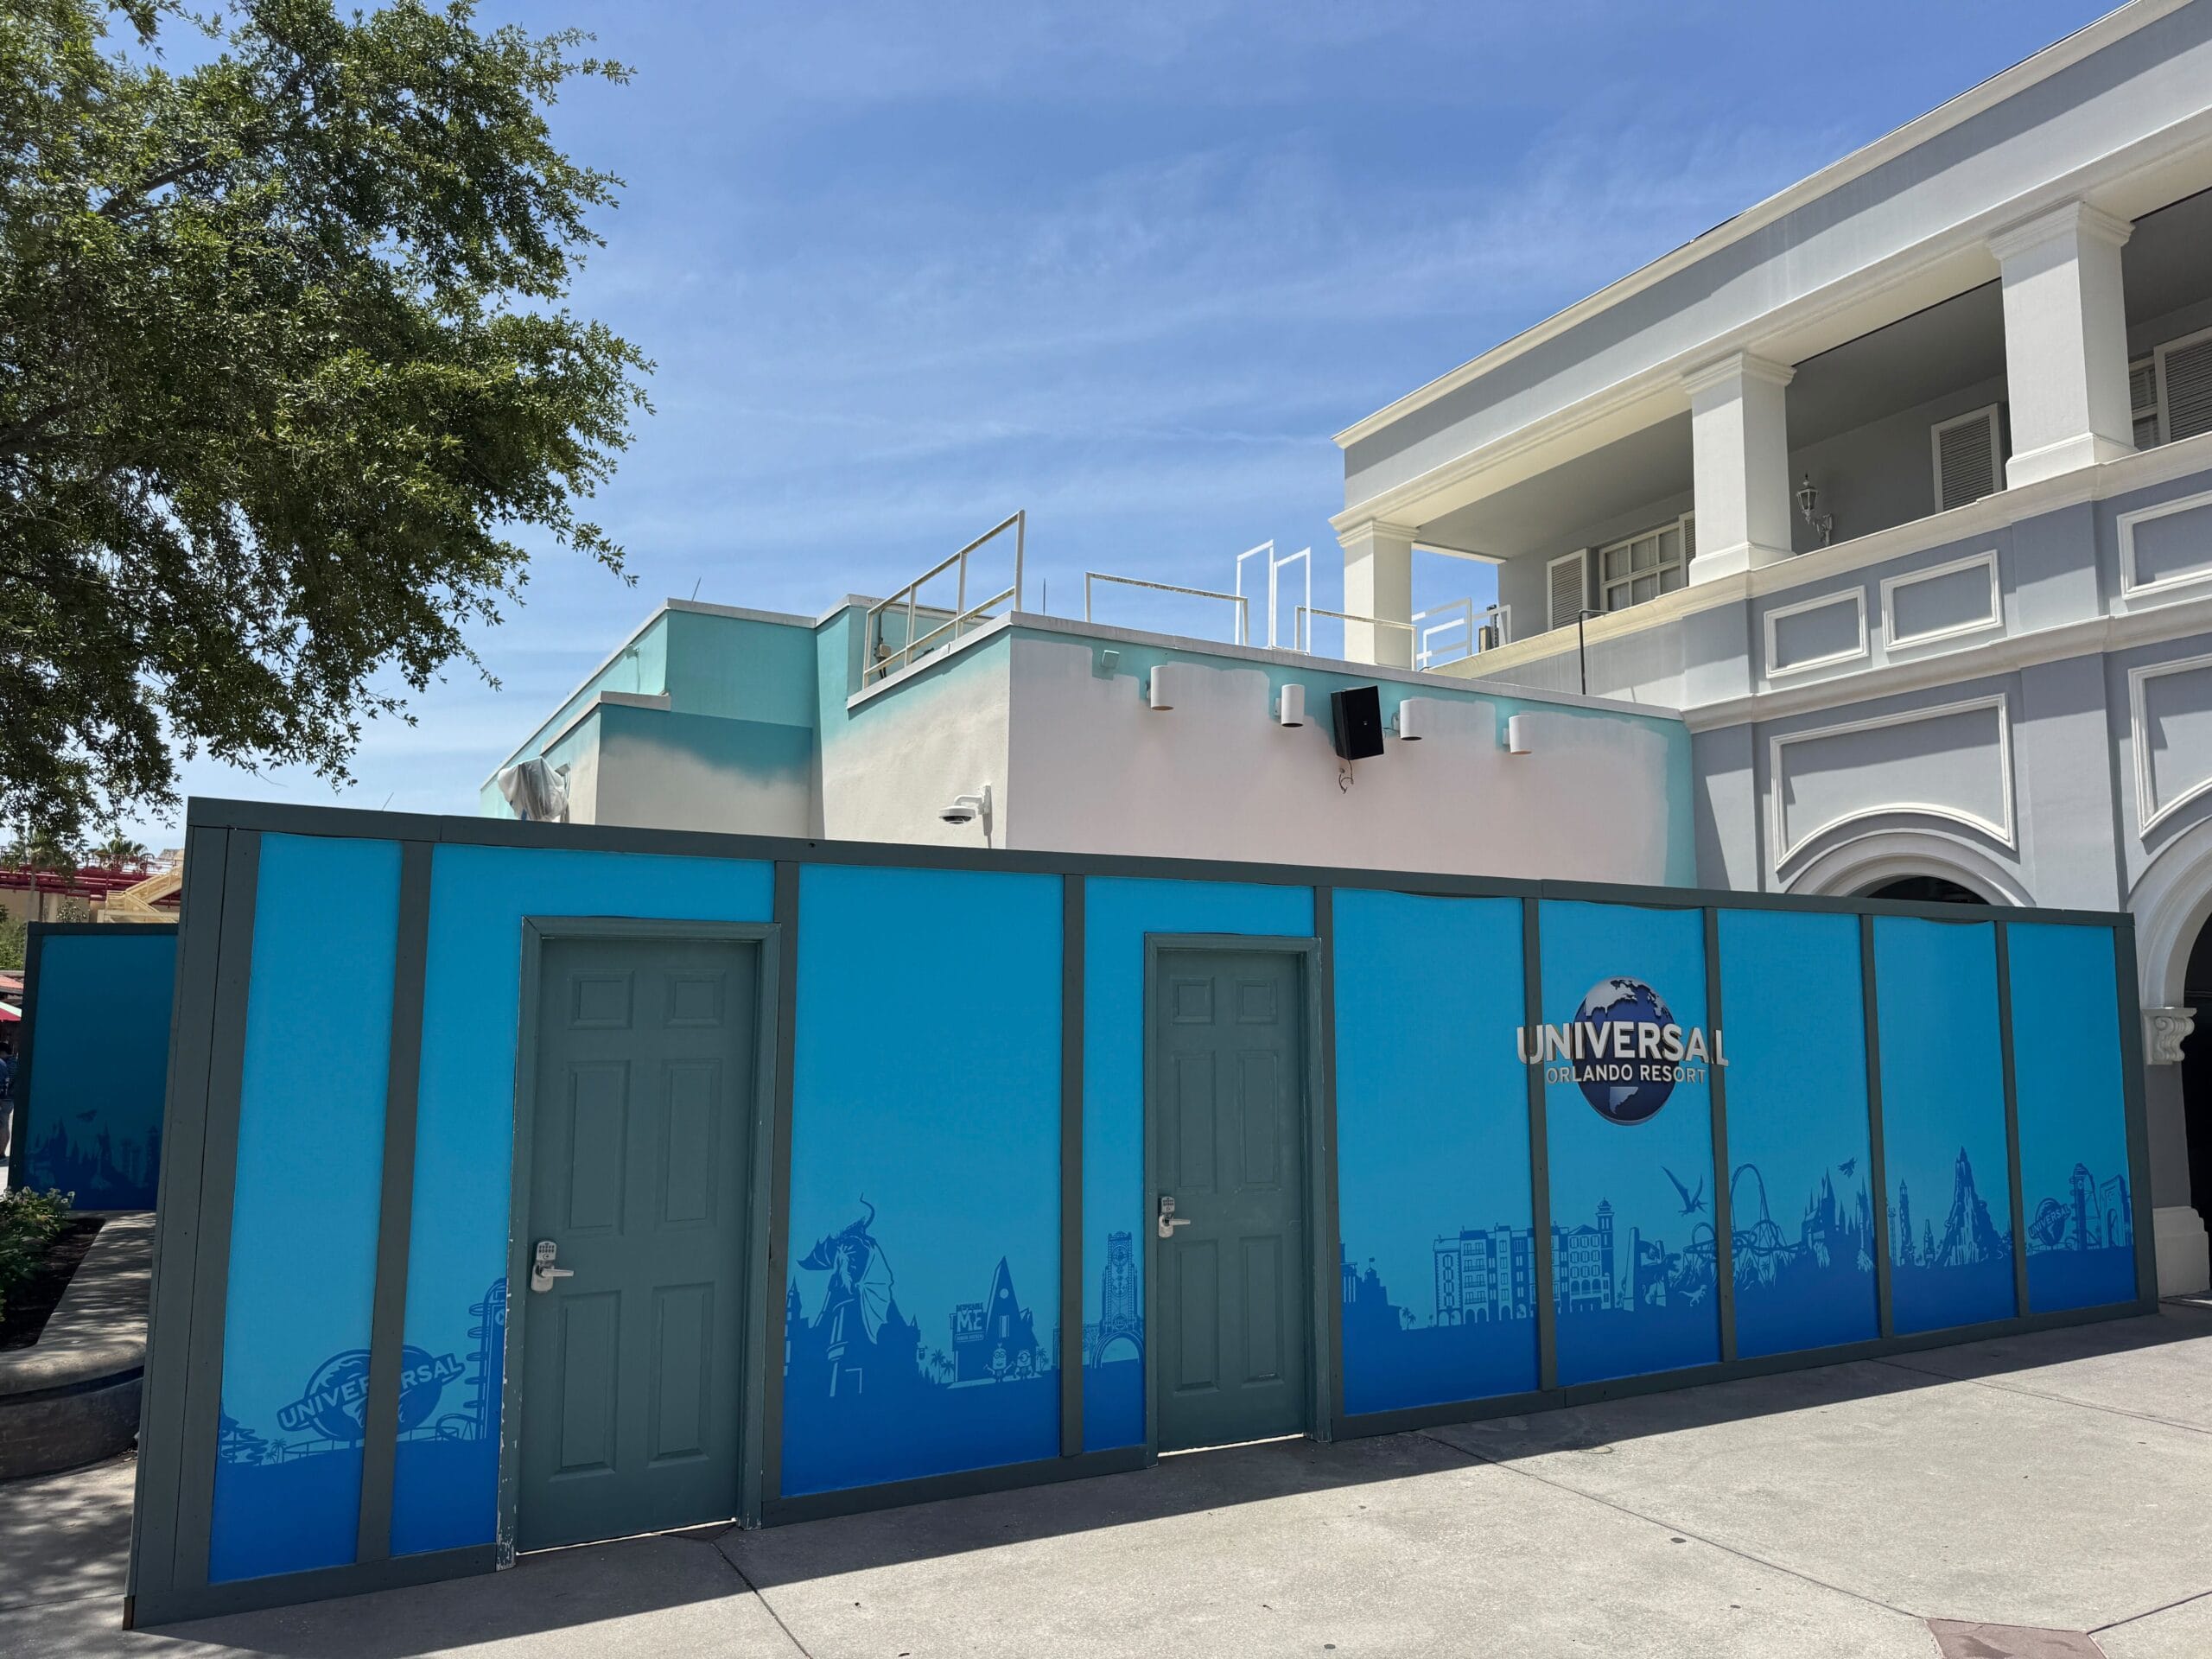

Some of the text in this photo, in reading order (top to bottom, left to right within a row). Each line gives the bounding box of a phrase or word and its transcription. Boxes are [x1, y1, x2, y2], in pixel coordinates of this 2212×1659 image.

[1516, 1021, 1729, 1067] UNIVERSAL
[1547, 1064, 1706, 1084] ORLANDO RESORT
[2029, 1205, 2069, 1237] UNIVERSAL
